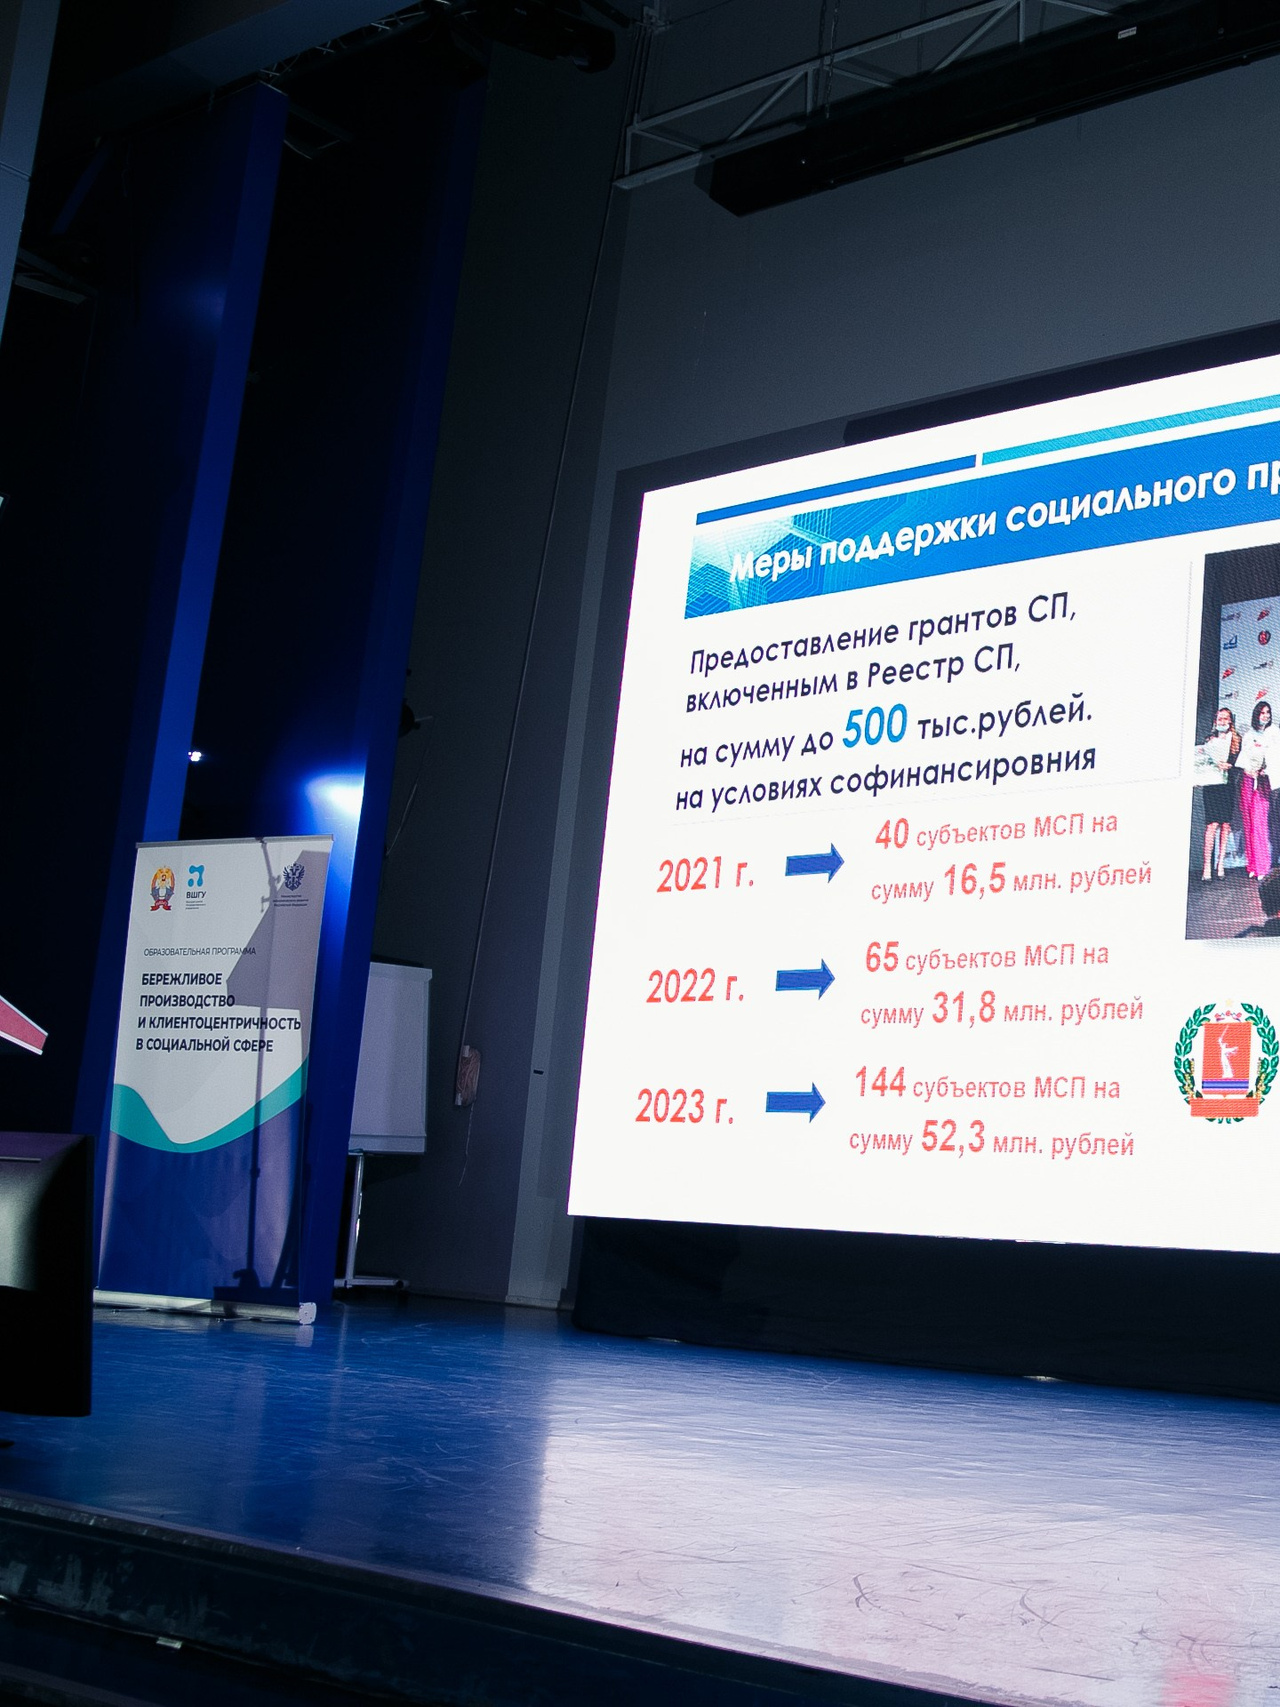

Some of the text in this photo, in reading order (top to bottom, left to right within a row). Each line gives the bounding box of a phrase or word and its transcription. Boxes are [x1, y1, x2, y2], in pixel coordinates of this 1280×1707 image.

[729, 539, 812, 585] Меры
[820, 508, 998, 567] поддержки
[1005, 465, 1237, 533] социального
[689, 590, 1077, 678] Предоставление грантов СП,
[685, 642, 1021, 714] включенным в Реестр СП,
[680, 692, 1093, 770] на сумму до 500 тыс.рублей.
[674, 747, 1097, 813] на условиях софинансировния
[874, 812, 1119, 852] 40 субъектов МСП на
[656, 856, 755, 893] 2021 г.
[870, 858, 1153, 904] сумму 16,5 млн. рублей
[143, 947, 257, 957] ОБРАЗОВАТЕЛЬНАЯ ПРОГРАММА
[865, 940, 1110, 976] 65 субъектов МСП на
[141, 972, 223, 986] БЕРЕЖЛИВОЕ
[645, 968, 745, 1004] 2022 г.
[139, 994, 236, 1009] ПРОИЗВОДСТВО
[860, 990, 1144, 1030] сумму 31,8 млн. рублей
[137, 1016, 302, 1031] И КЛИЕНТОЦЕНТРИЧНОСТЬ
[135, 1035, 274, 1053] В СОЦИАЛЬНОЙ СФЕРЕ
[855, 1065, 1122, 1102] 144 субъектов МСП на
[635, 1088, 735, 1125] 2023 г.
[849, 1119, 1136, 1161] сумму 52,3 млн. рублей
